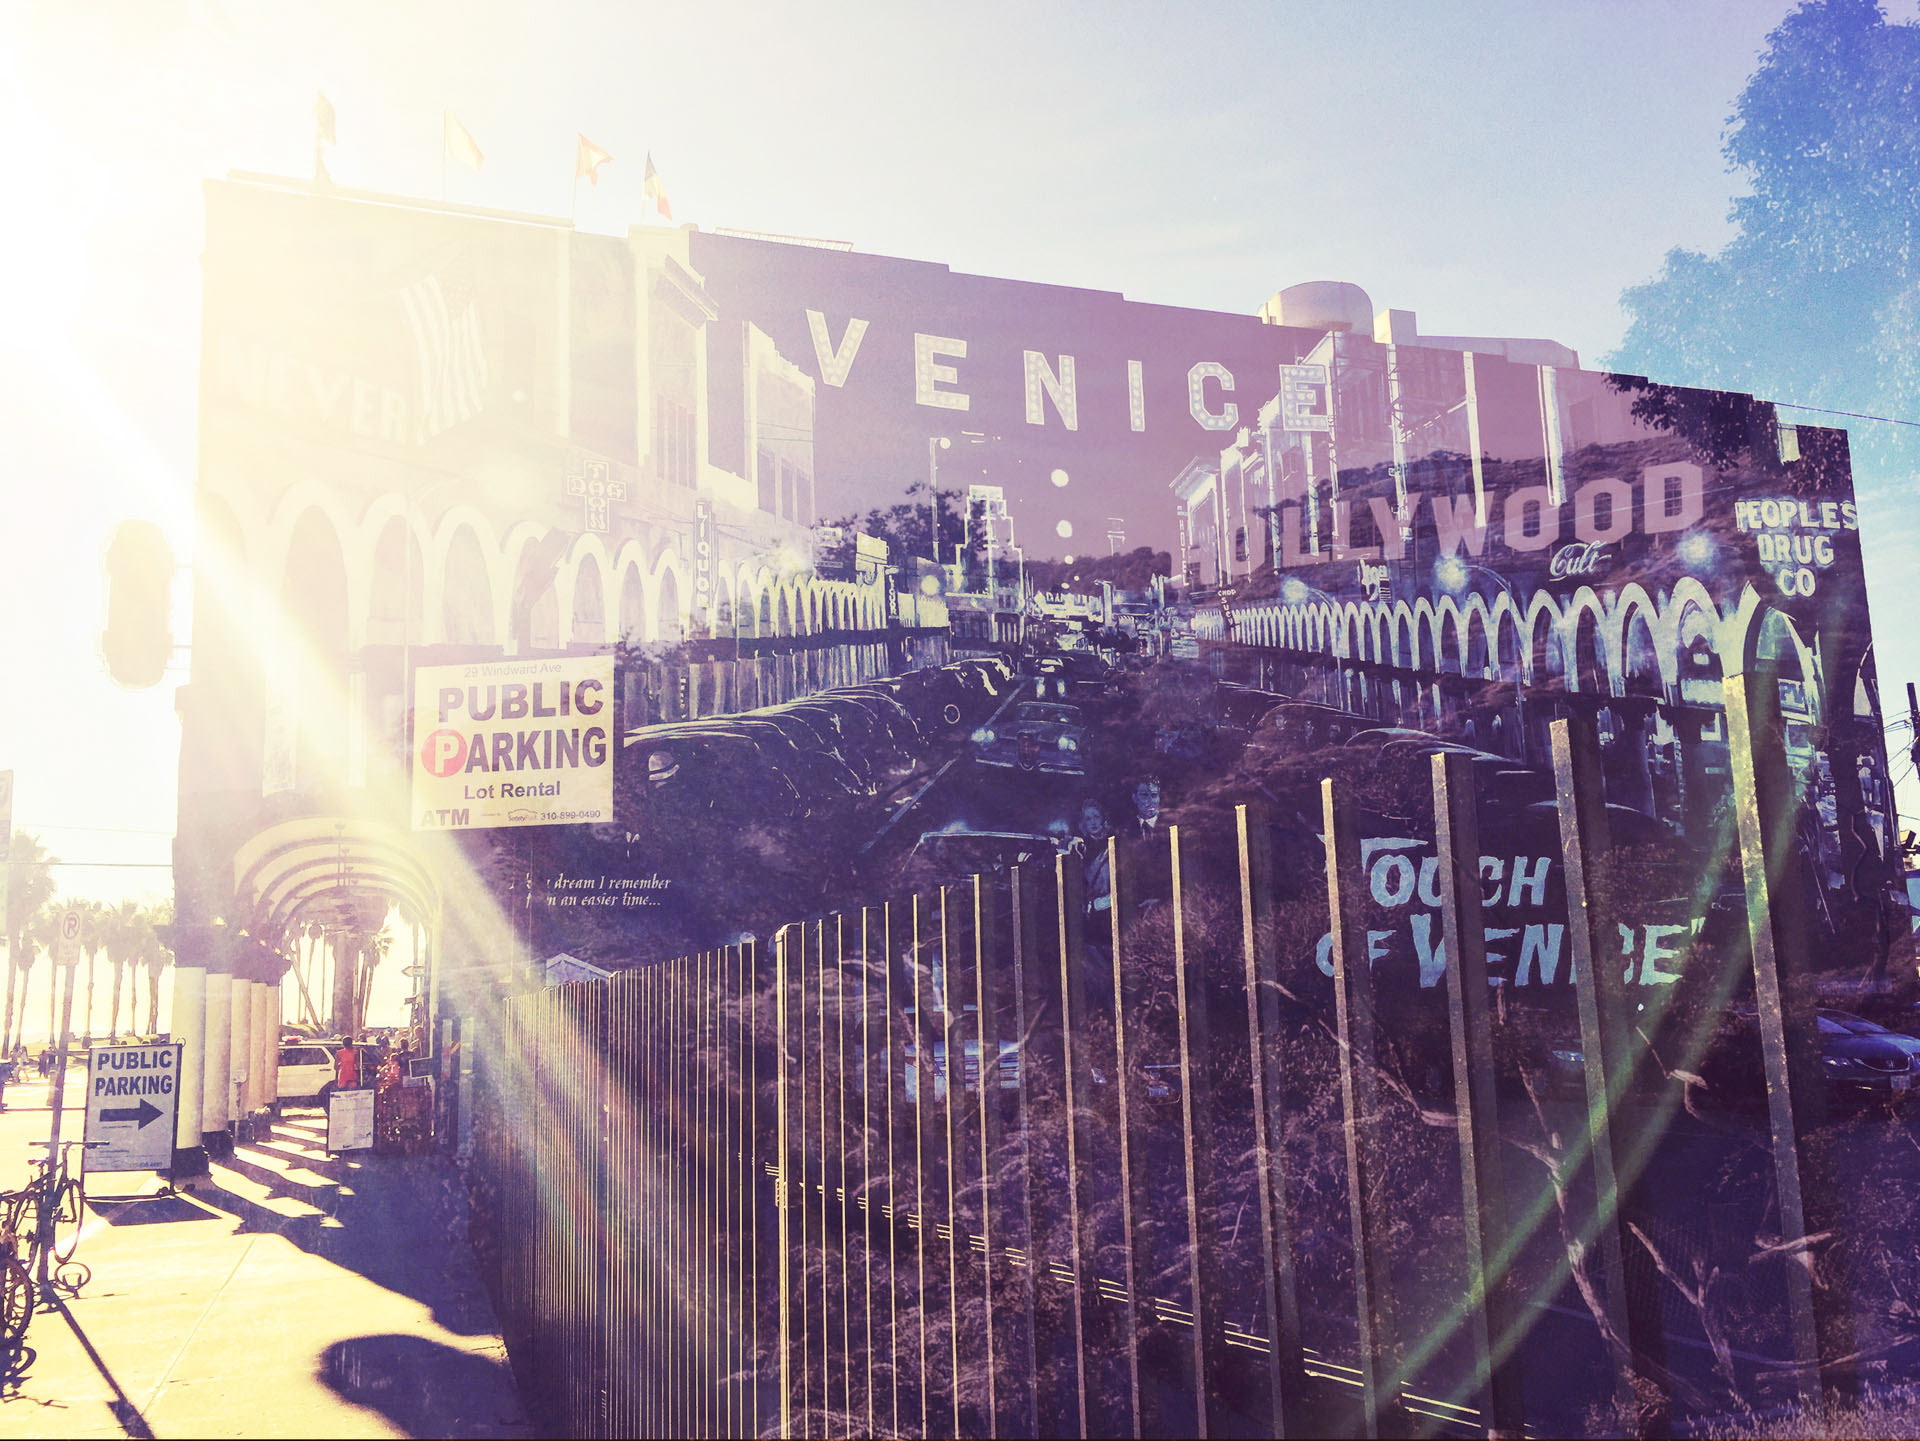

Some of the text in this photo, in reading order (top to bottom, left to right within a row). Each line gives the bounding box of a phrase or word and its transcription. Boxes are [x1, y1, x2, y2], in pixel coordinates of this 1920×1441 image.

[805, 309, 1330, 432] VENICE
[1757, 533, 1835, 565] DRUG
[1777, 567, 1816, 598] CO
[463, 666, 479, 679] 29
[481, 663, 537, 677] Windward
[438, 679, 604, 723] PUBLIC
[430, 727, 607, 776] PARKING
[464, 781, 561, 800] Lot Rental
[421, 808, 470, 826] ATM
[554, 872, 595, 890] dream
[608, 873, 672, 890] remember
[581, 893, 619, 906] easier
[97, 1049, 173, 1071] PUBLIC
[94, 1074, 173, 1096] PARKING
